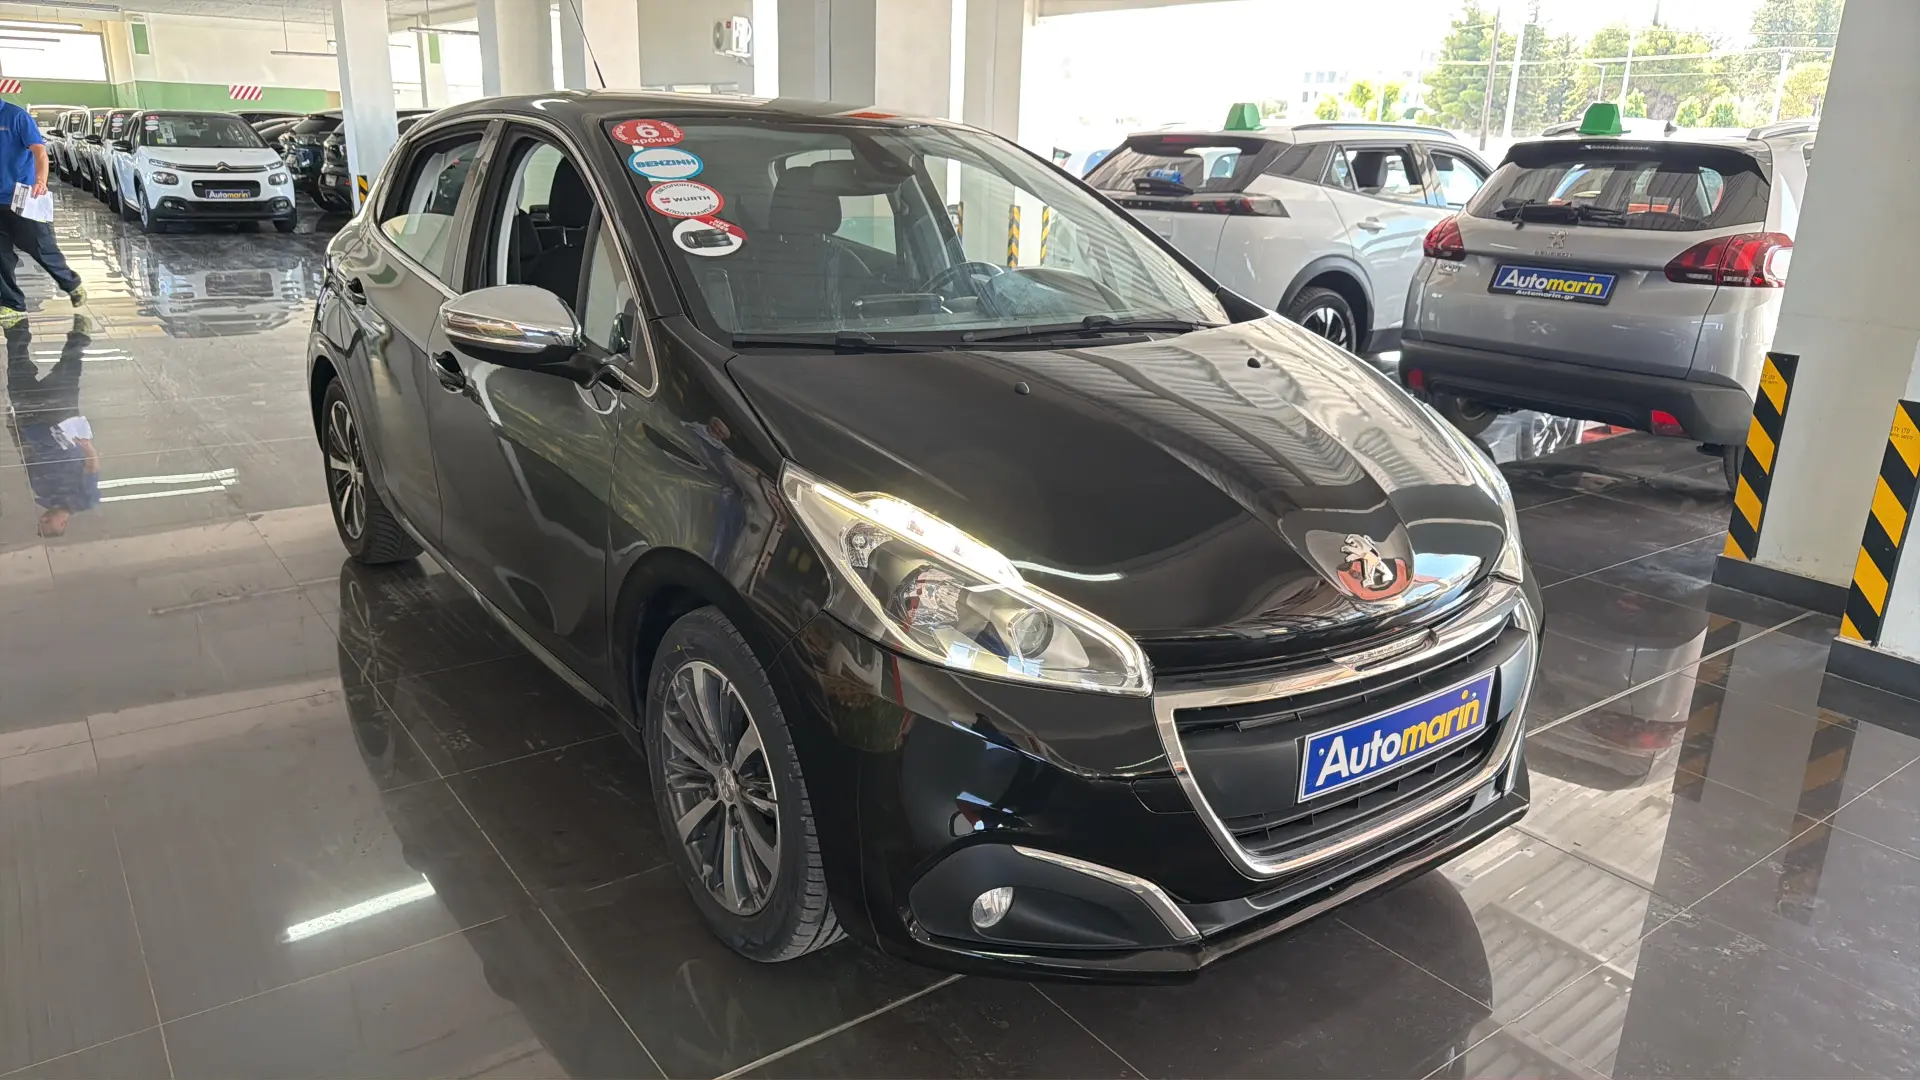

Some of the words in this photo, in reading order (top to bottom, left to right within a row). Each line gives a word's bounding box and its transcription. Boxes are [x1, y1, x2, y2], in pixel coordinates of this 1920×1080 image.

[636, 125, 660, 138] 6
[209, 190, 248, 198] Automarin
[1501, 269, 1603, 295] Automarin
[1516, 290, 1575, 300] Automarin.gr
[1315, 690, 1480, 787] Automarin
